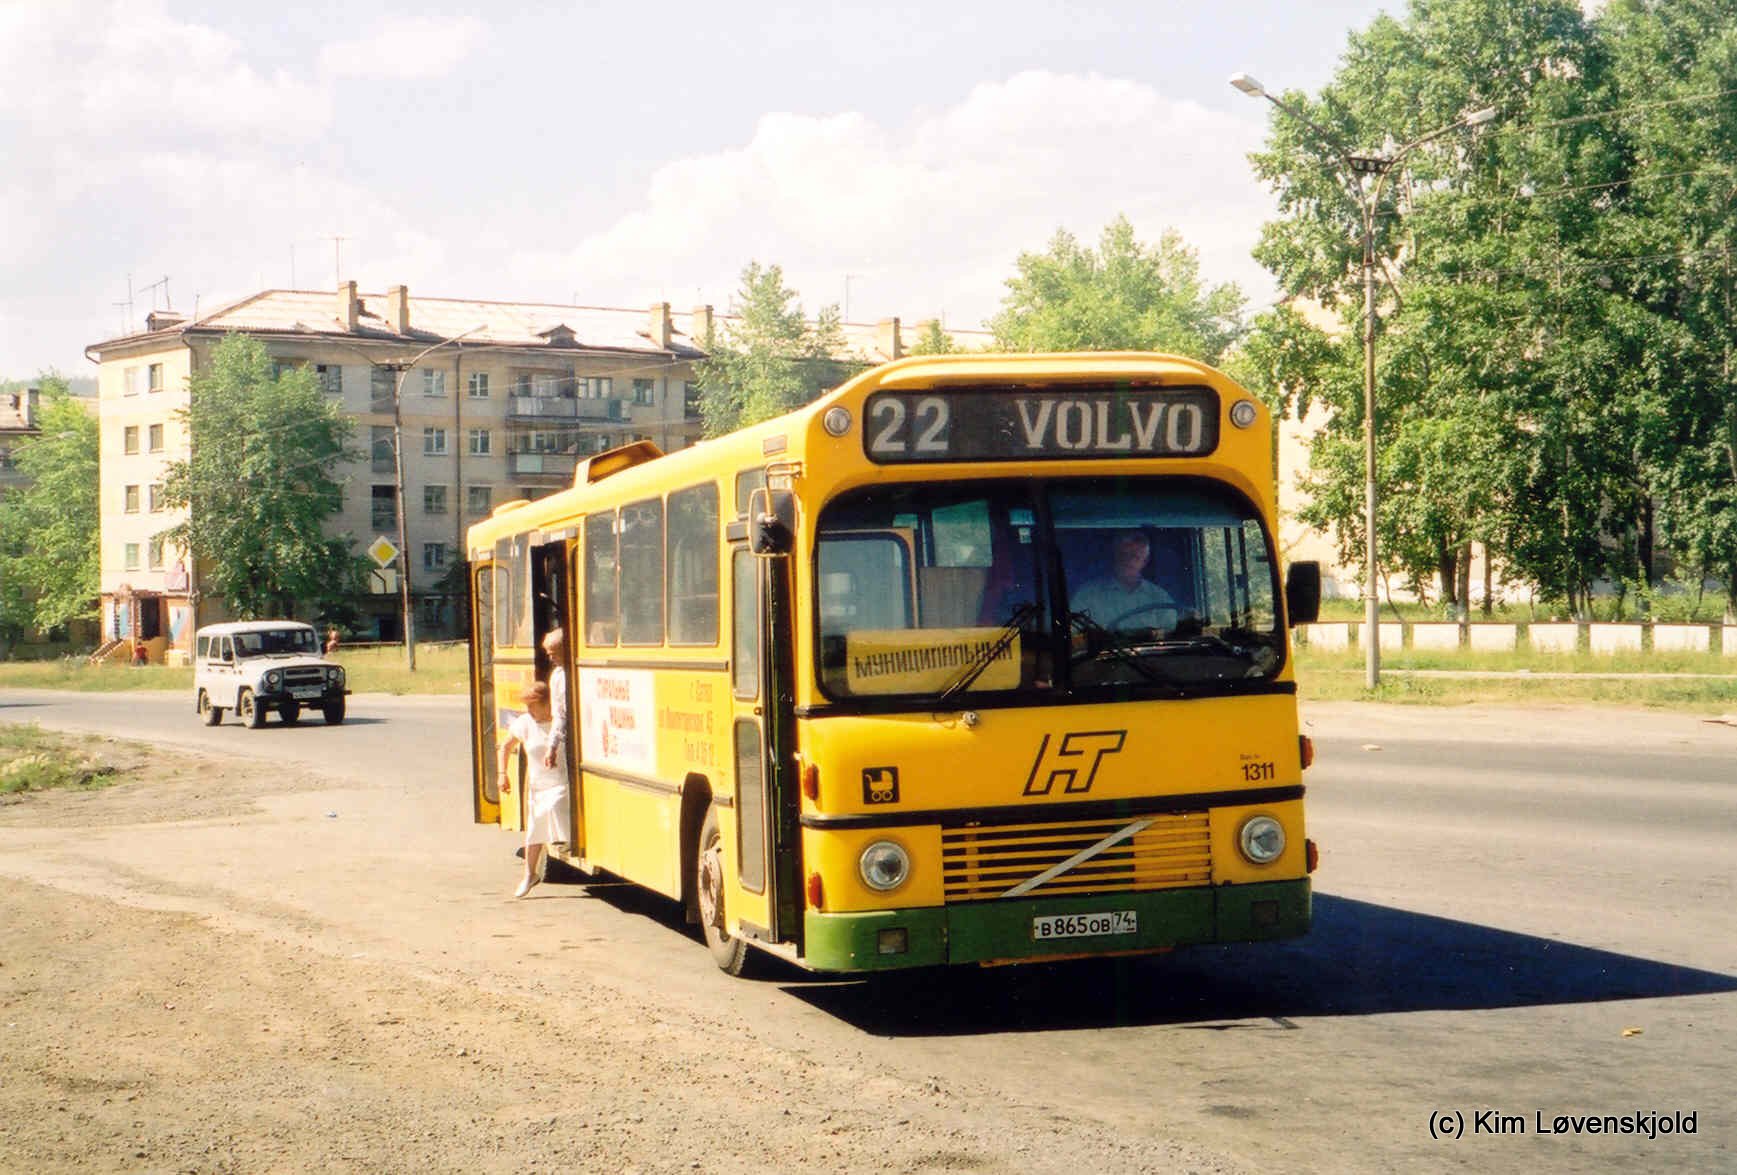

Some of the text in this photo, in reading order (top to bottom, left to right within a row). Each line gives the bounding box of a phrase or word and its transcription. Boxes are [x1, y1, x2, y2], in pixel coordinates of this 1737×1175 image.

[872, 397, 1203, 453] 22 VOLVO
[1241, 761, 1275, 781] 1311
